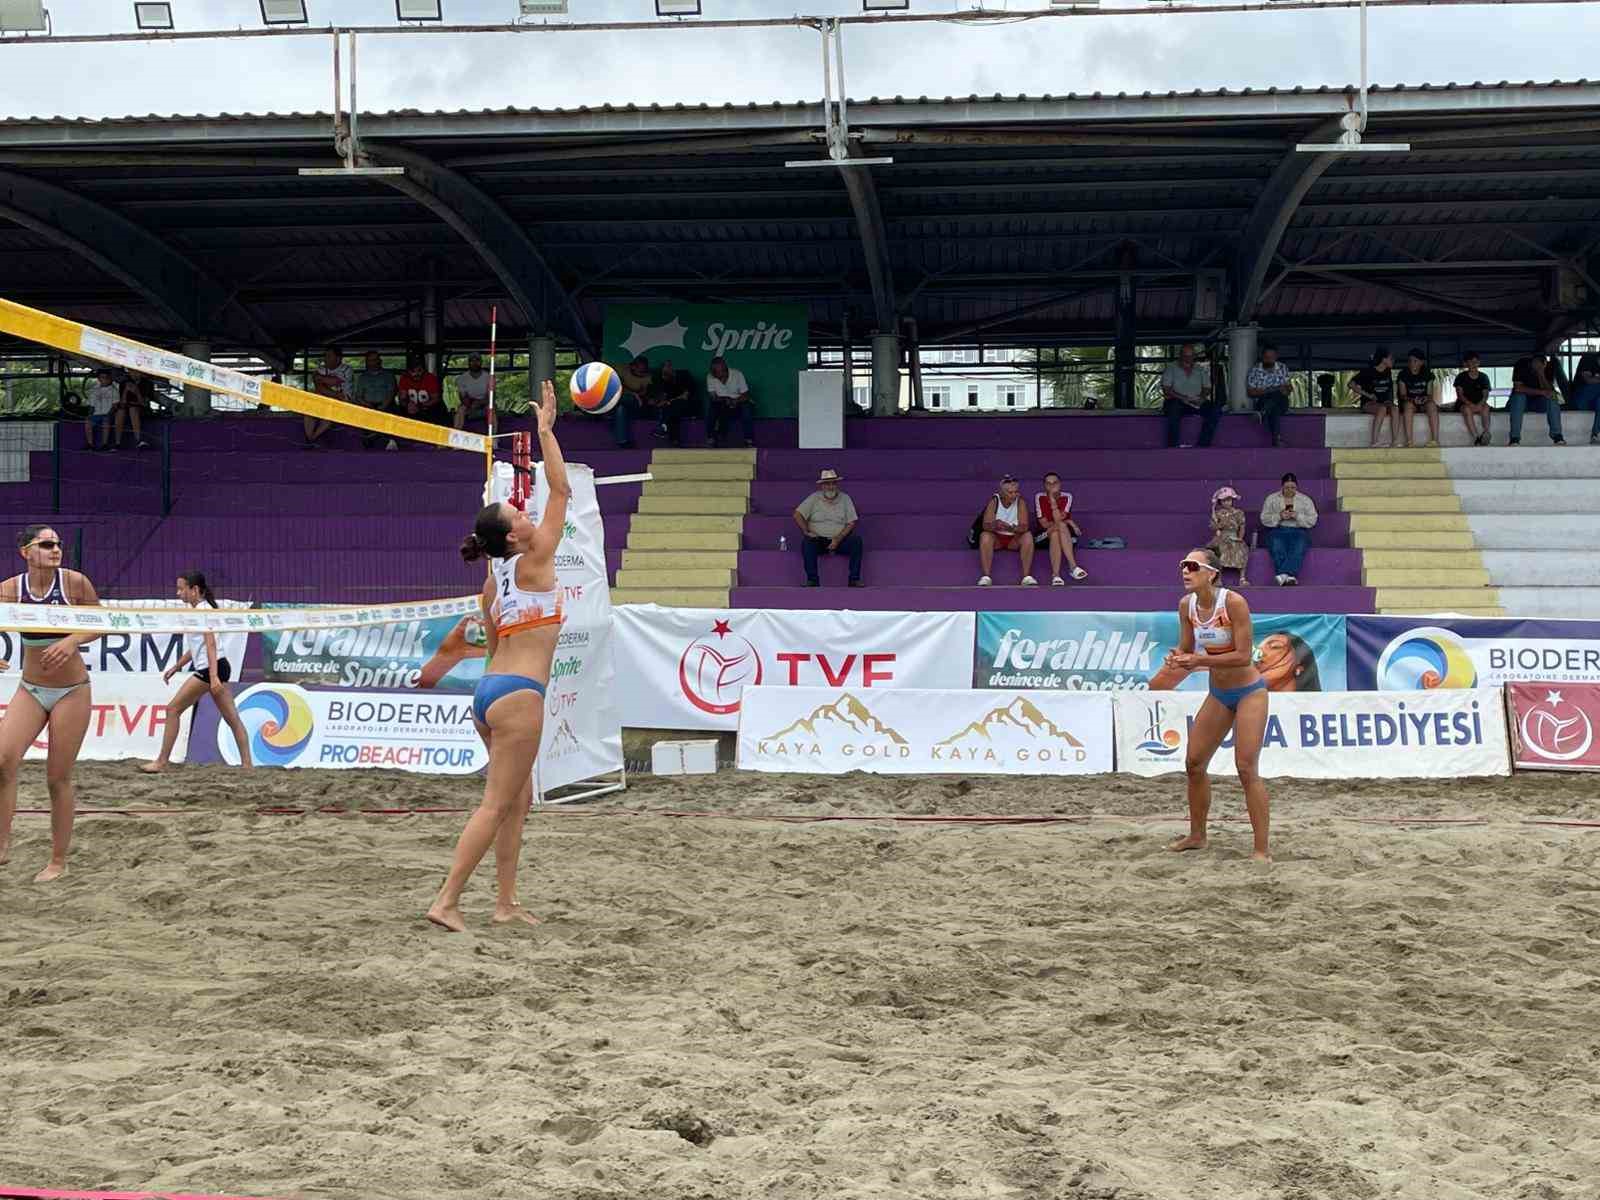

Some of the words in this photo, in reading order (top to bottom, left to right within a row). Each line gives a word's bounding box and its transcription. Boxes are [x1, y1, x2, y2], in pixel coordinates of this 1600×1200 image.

[701, 321, 793, 357] Sprite
[501, 577, 511, 598] 2
[564, 585, 584, 601] TVF
[993, 628, 1160, 671] ferahlık
[1489, 648, 1600, 671] BIODER
[272, 658, 322, 674] denince
[323, 659, 340, 674] de
[338, 660, 423, 688] Sprite
[551, 655, 584, 681] Sprite
[776, 653, 897, 688] TVF
[989, 671, 1042, 687] denince
[1043, 673, 1062, 688] de
[327, 700, 474, 725] BIODERMA
[560, 692, 577, 708] TVF
[91, 704, 176, 737] TVF
[325, 724, 389, 733] LABORATOIRE
[1300, 701, 1483, 748] BELEDİYESİ
[319, 743, 475, 768] PROBEACHTOUR
[758, 742, 823, 756] KAYA
[841, 744, 911, 758] GOLD
[931, 746, 996, 761] KAYA
[1016, 748, 1087, 762] GOLD
